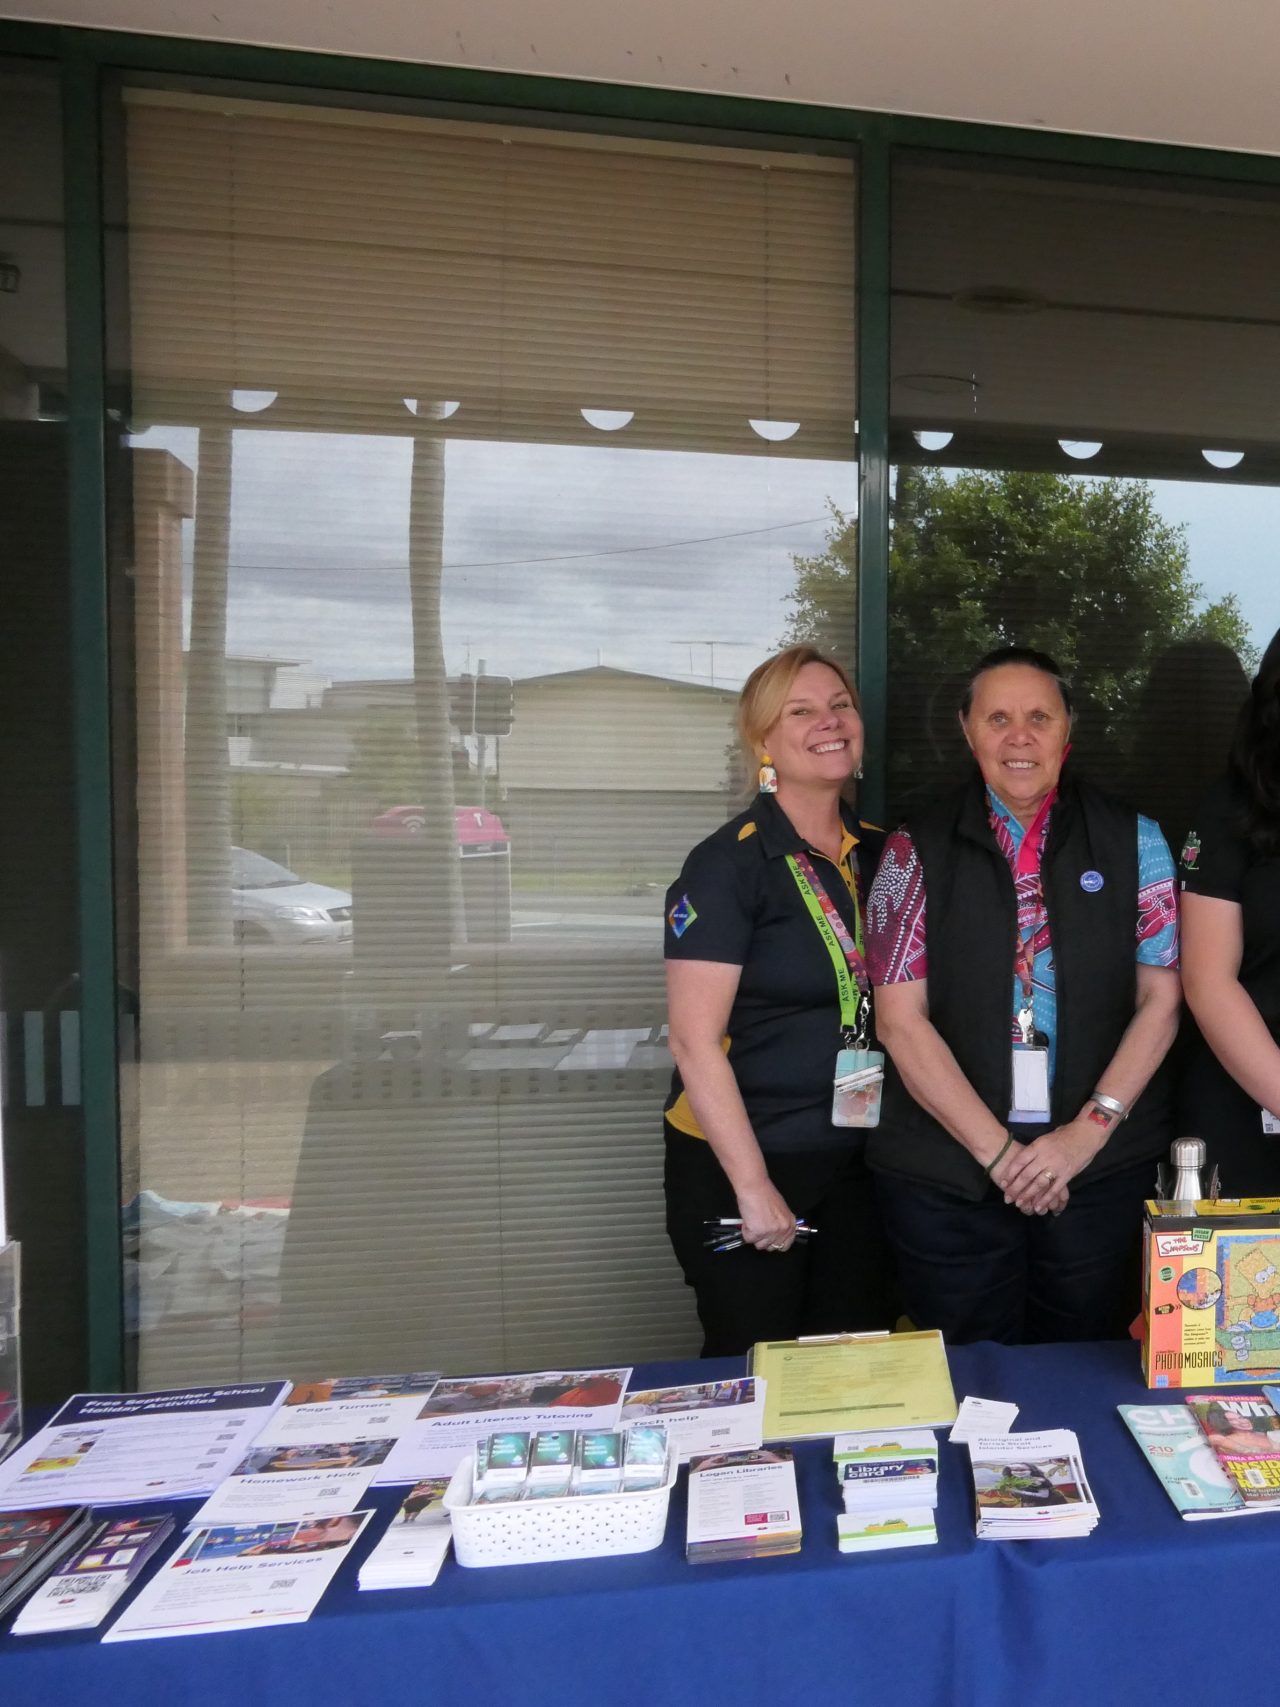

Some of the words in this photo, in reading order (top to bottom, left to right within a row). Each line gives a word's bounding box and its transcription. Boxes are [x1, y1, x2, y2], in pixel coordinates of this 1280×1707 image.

[792, 865, 802, 877] ME
[800, 878, 811, 896] ASK
[816, 916, 827, 927] ME
[823, 928, 835, 947] ASK
[838, 969, 845, 981] ME
[840, 982, 849, 1002] ASK
[1156, 1351, 1222, 1370] PHOTOMOSAICS
[85, 1399, 122, 1407] Free
[125, 1390, 209, 1404] September
[213, 1387, 266, 1396] School
[79, 1403, 138, 1414] Holiday
[143, 1398, 217, 1409] Activities
[296, 1405, 333, 1413] Page
[338, 1402, 392, 1410] Turners
[474, 1414, 532, 1424] Literacy
[535, 1412, 593, 1421] Tutoring
[736, 1465, 783, 1474] Libraries
[849, 1465, 904, 1473] Library
[849, 1470, 884, 1478] card
[240, 1475, 321, 1484] Homework
[326, 1471, 361, 1480] Help
[182, 1566, 211, 1575] Job
[215, 1563, 254, 1573] Help
[257, 1557, 323, 1568] Services
